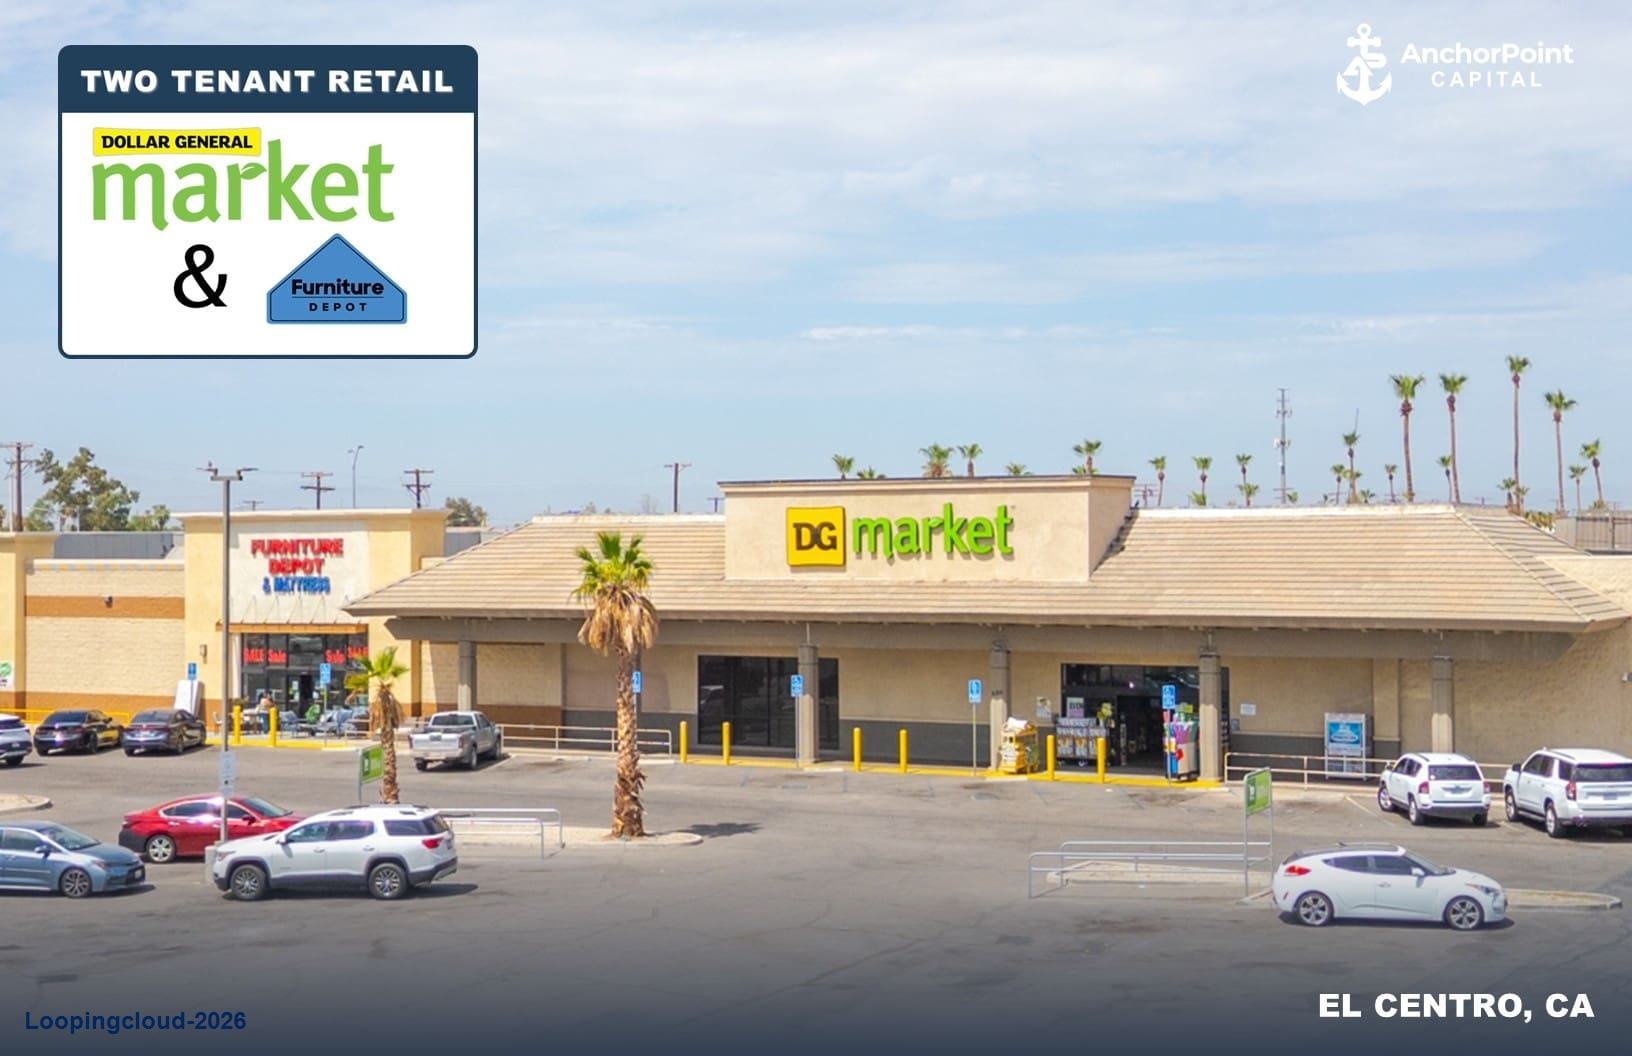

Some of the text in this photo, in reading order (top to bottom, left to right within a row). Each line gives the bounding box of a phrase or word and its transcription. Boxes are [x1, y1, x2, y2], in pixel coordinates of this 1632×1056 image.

[793, 502, 1013, 559] DG market
[251, 538, 343, 557] FURNITURE
[269, 558, 324, 575] DEPOT
